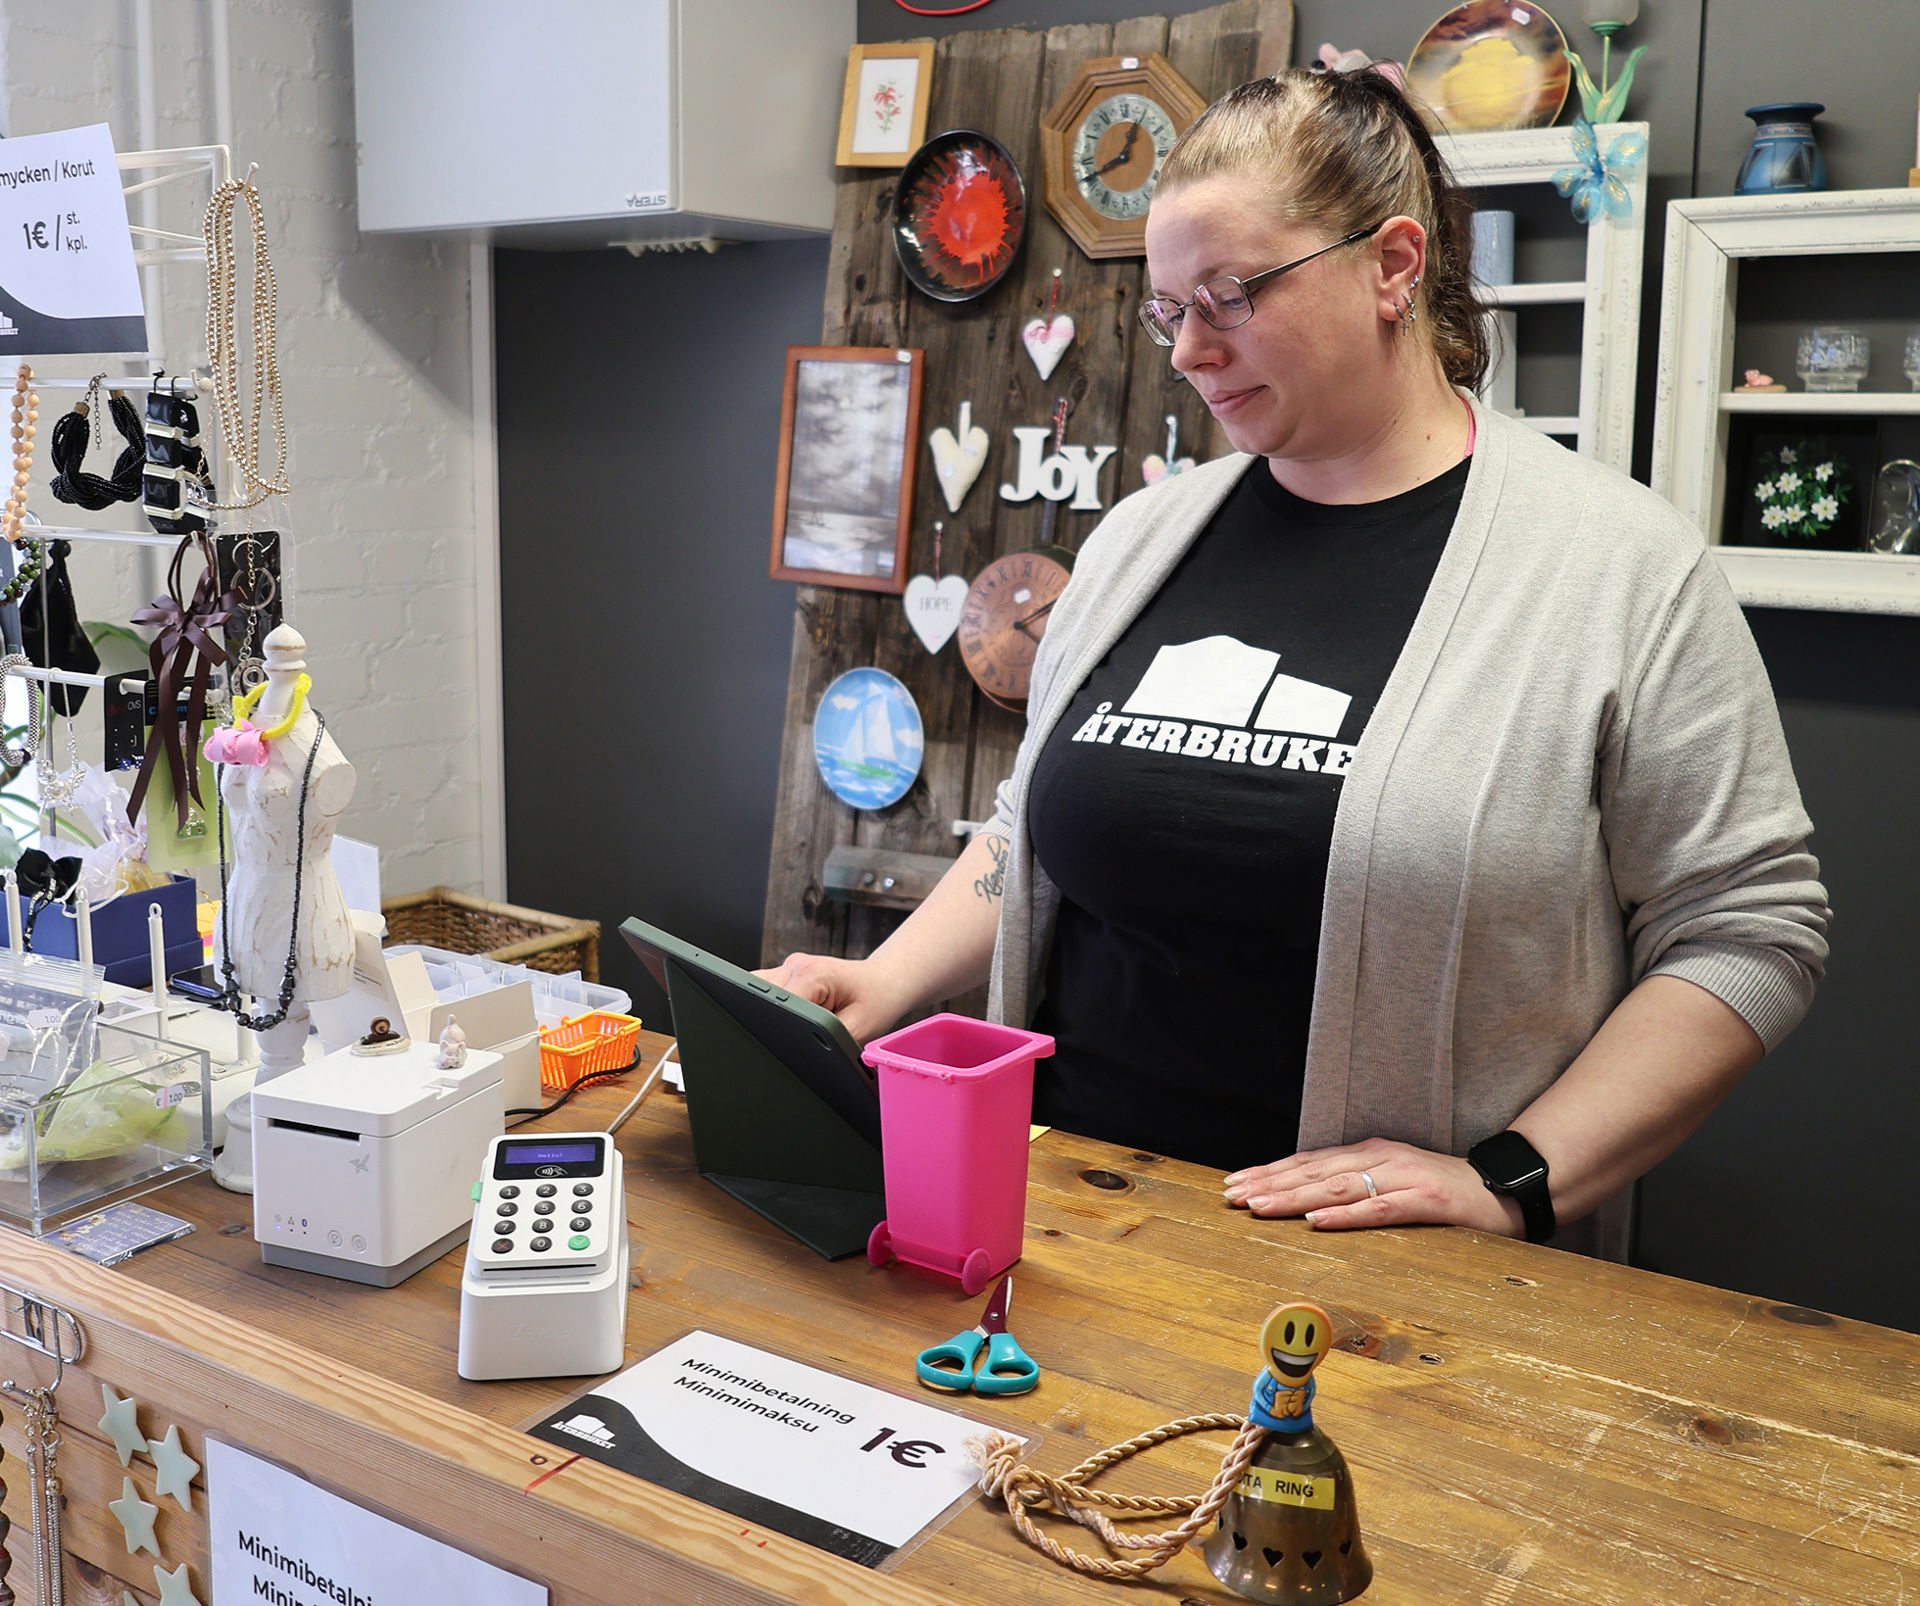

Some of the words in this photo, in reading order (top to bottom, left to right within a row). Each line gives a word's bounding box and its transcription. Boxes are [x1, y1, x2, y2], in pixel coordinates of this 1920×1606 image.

[61, 159, 96, 179] Korut
[625, 194, 666, 208] STERA
[66, 211, 81, 225] st.
[65, 235, 88, 253] kpl.
[920, 597, 953, 611] HOPE
[1071, 701, 1357, 776] ÅTERBRUKE
[681, 1358, 856, 1425] Minimibetalning
[673, 1376, 819, 1433] Minimimaksu
[1275, 1480, 1314, 1497] RING
